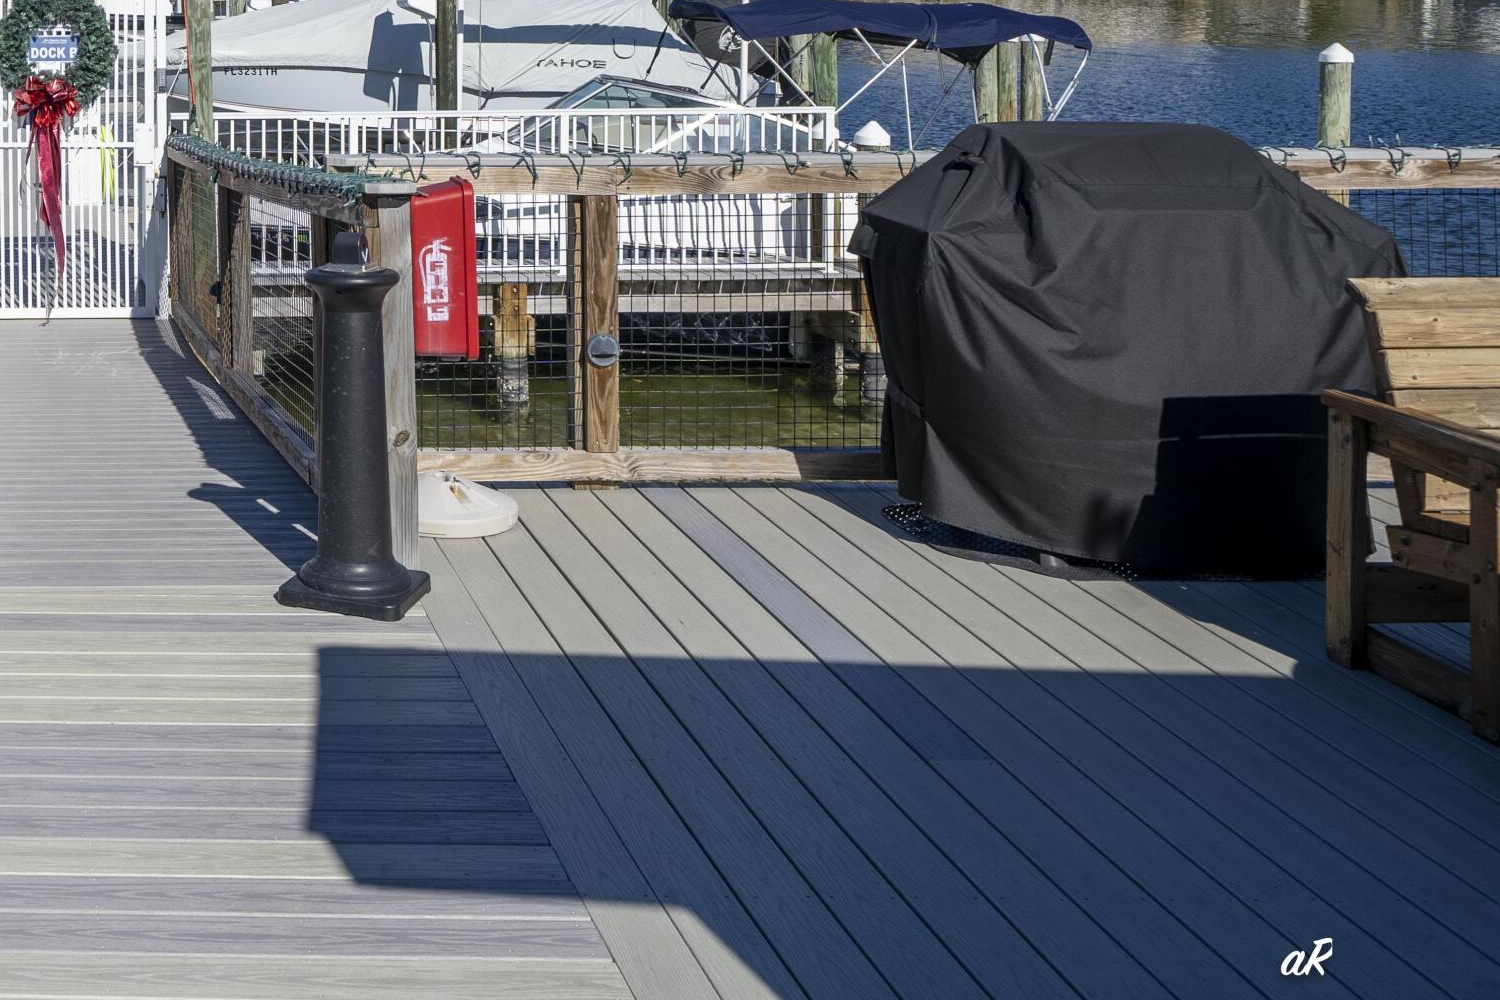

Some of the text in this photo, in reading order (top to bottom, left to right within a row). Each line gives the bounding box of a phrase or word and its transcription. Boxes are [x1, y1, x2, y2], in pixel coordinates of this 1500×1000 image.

[30, 47, 78, 59] DOCK B
[224, 67, 278, 76] FL3231TH
[429, 260, 445, 314] FIRE
